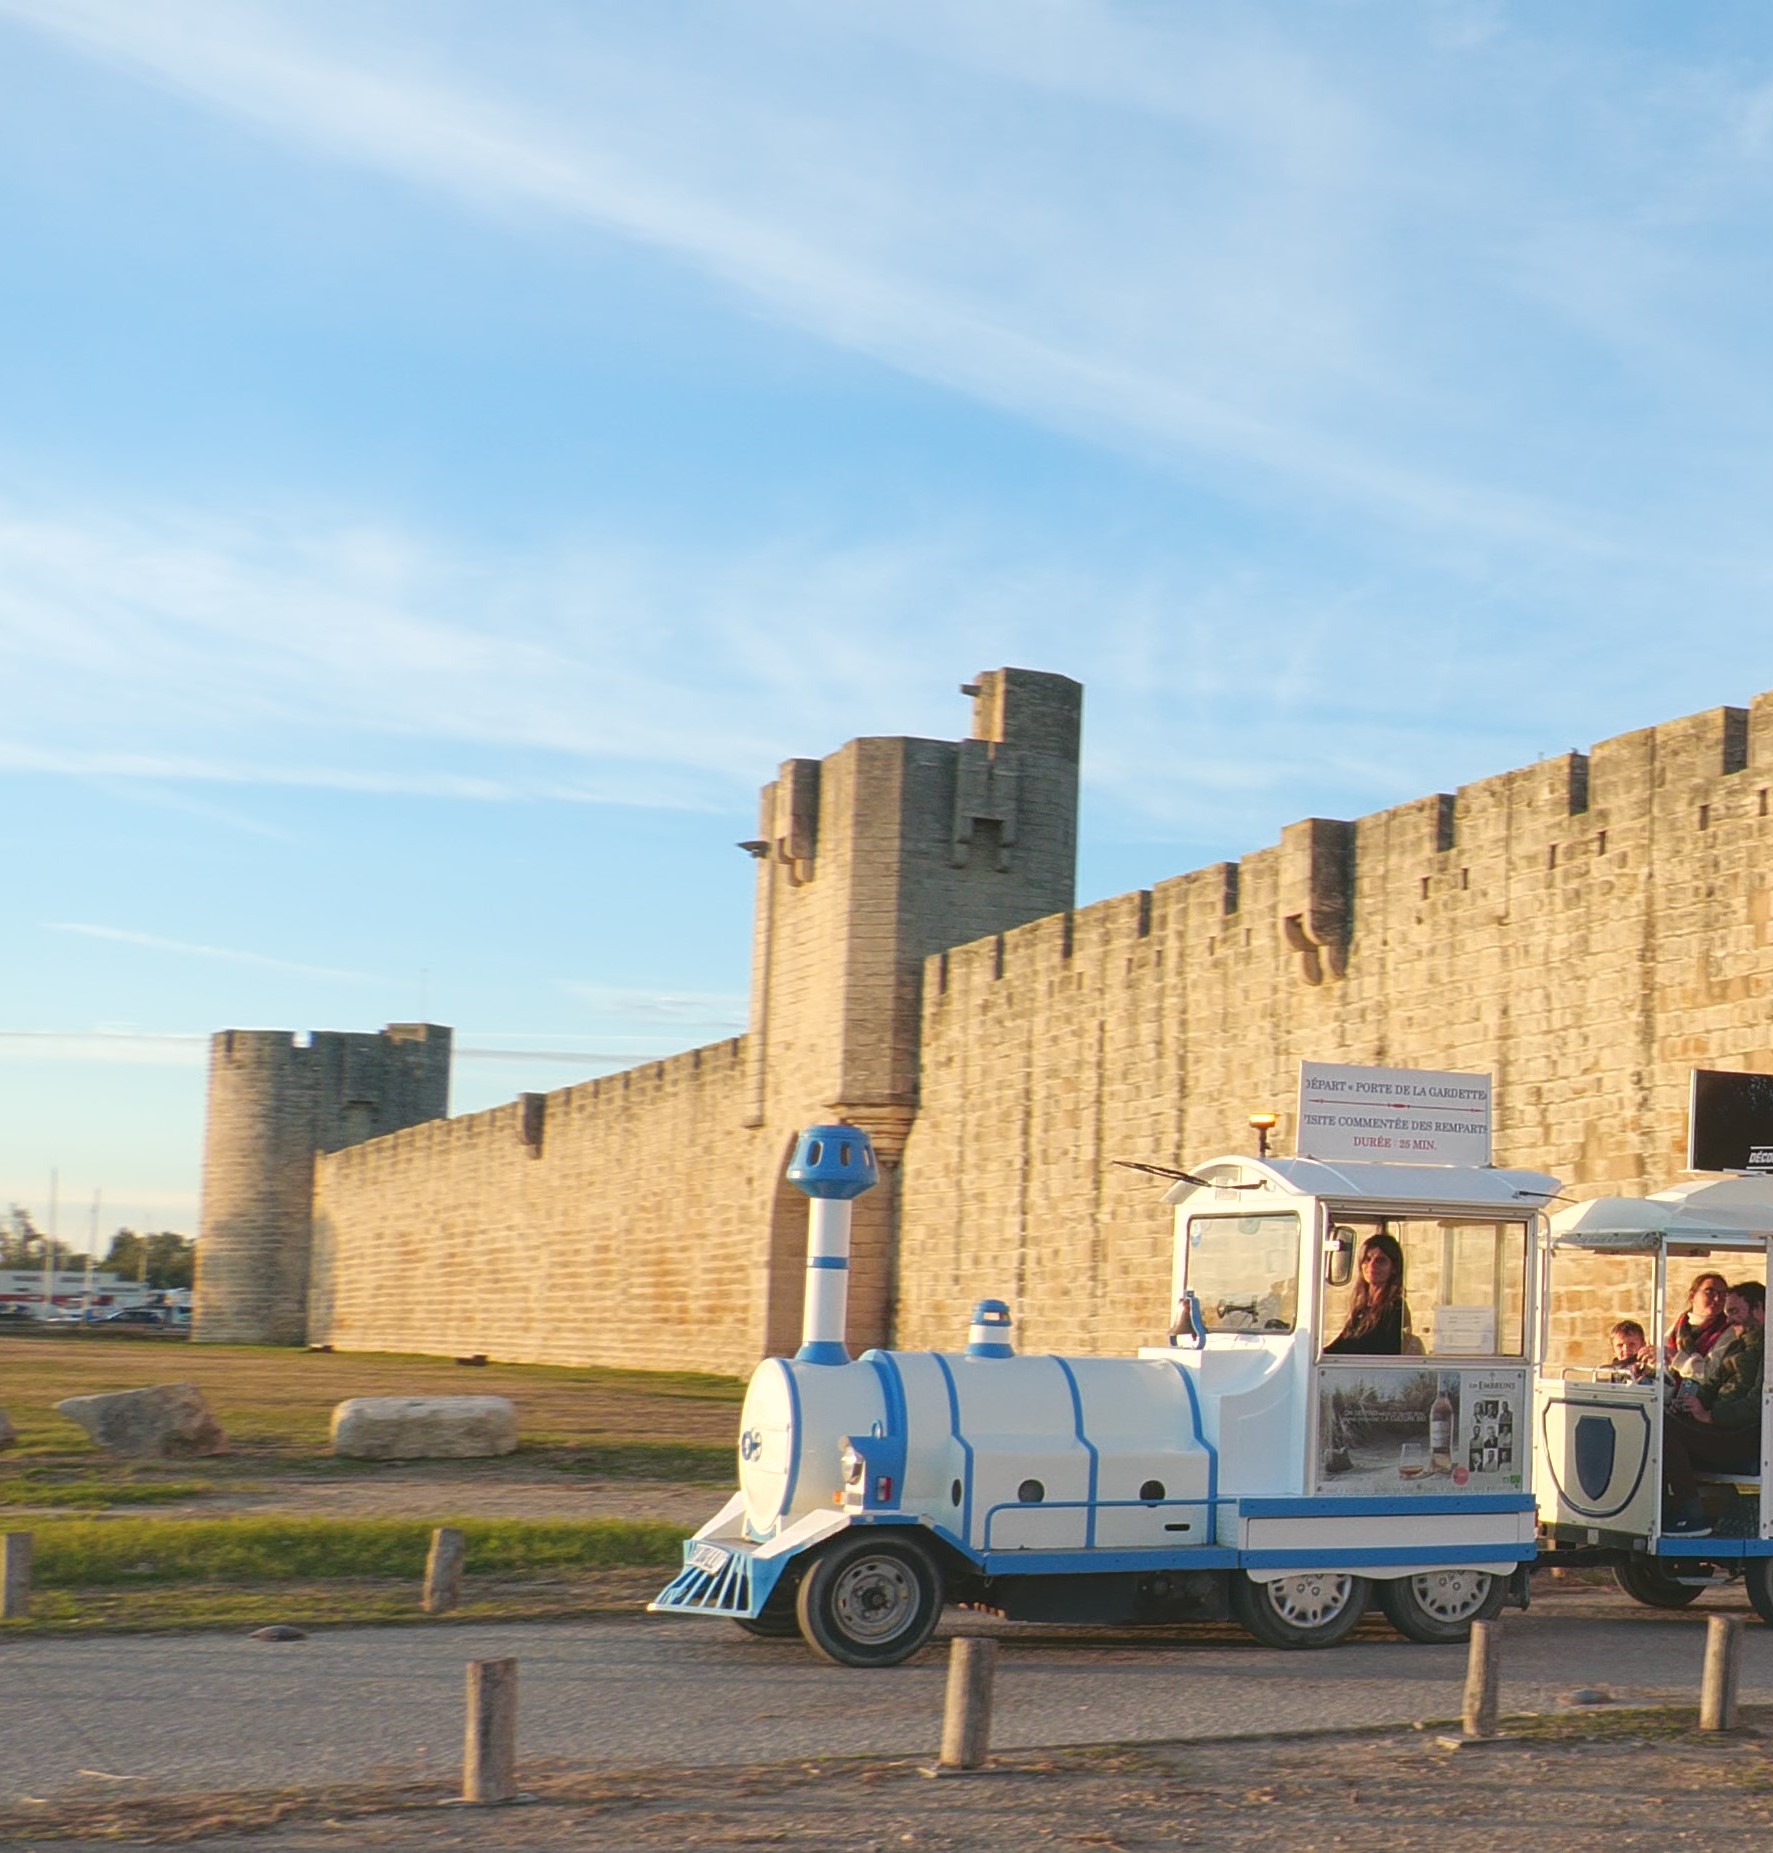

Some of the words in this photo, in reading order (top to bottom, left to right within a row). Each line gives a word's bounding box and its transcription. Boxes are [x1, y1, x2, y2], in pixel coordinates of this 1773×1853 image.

[1356, 1082, 1393, 1094] PORTE
[1395, 1084, 1411, 1096] DE
[1413, 1086, 1427, 1097] LA
[1339, 1116, 1409, 1130] COMMENTÉE
[1411, 1120, 1433, 1131] DES
[1353, 1135, 1392, 1148] DURÉE
[1399, 1139, 1411, 1149] 25
[1412, 1140, 1437, 1151] MIN.
